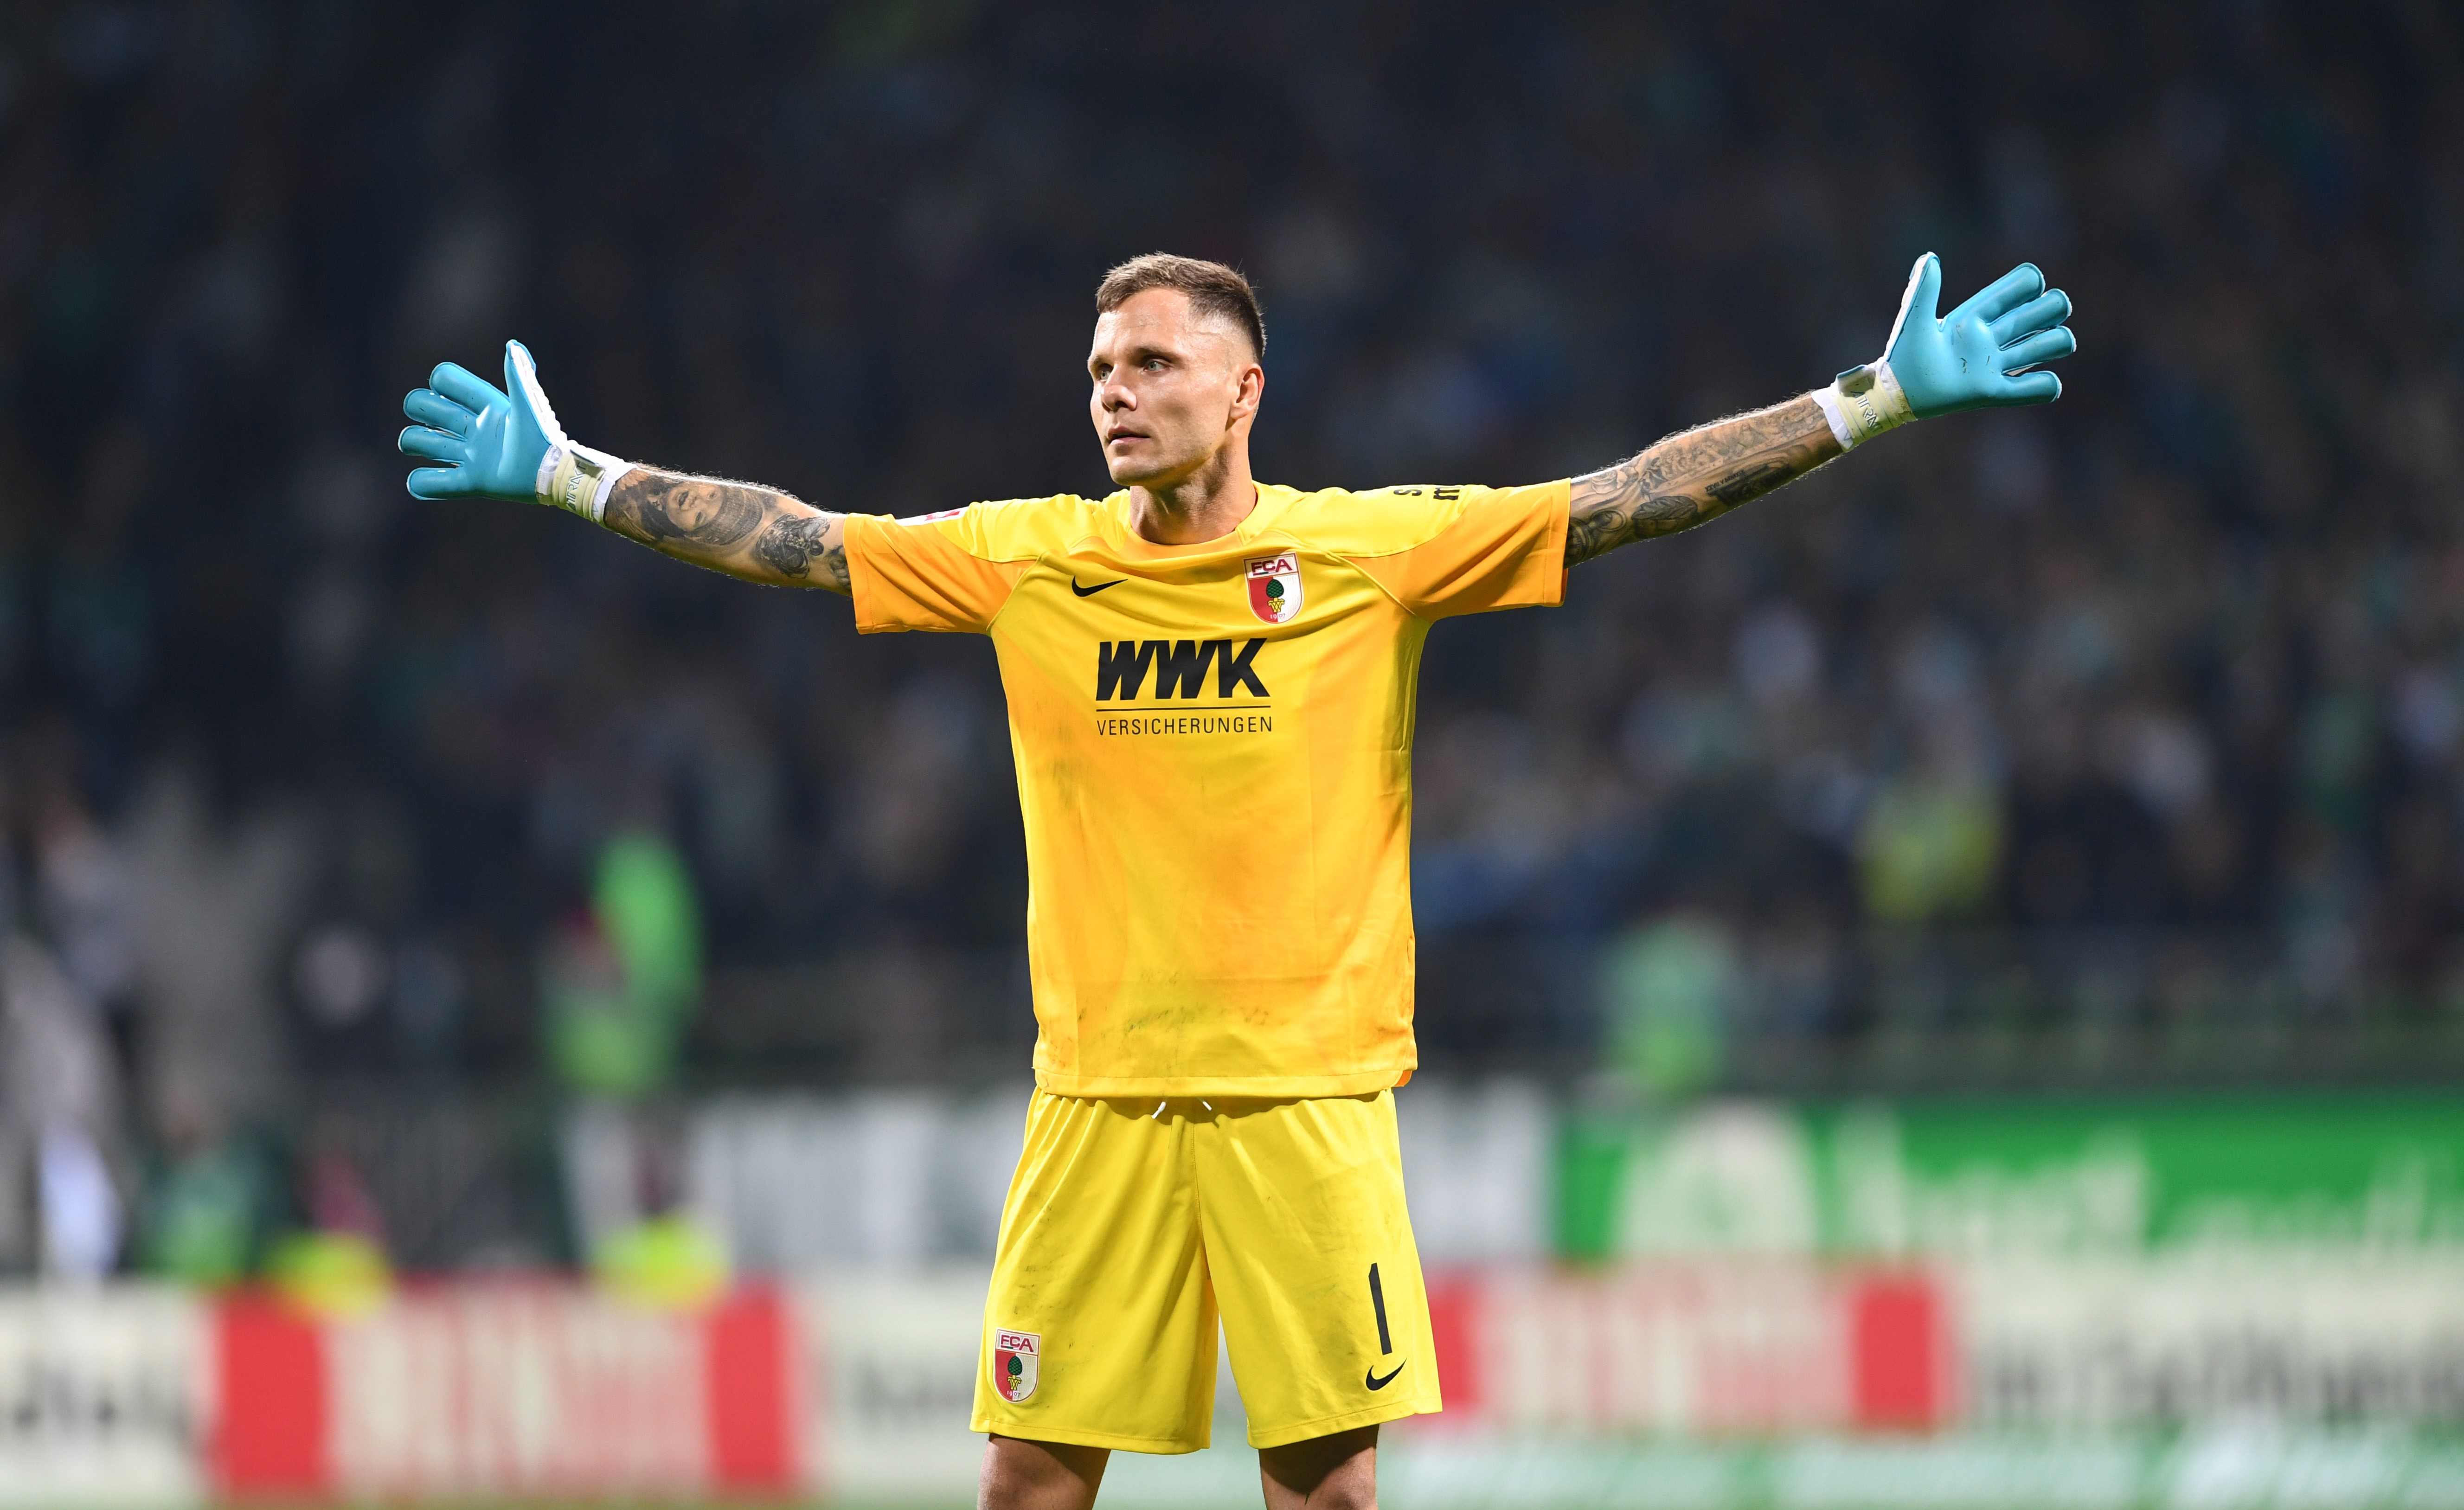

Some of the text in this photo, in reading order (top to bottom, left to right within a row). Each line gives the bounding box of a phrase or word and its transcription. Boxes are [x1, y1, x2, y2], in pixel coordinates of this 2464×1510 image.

[1251, 559, 1293, 573] FCA
[1096, 637, 1270, 701] WWK
[1096, 716, 1272, 736] VERSICHERUNGEN
[1368, 1262, 1392, 1356] 1
[1001, 1334, 1034, 1353] FCA
